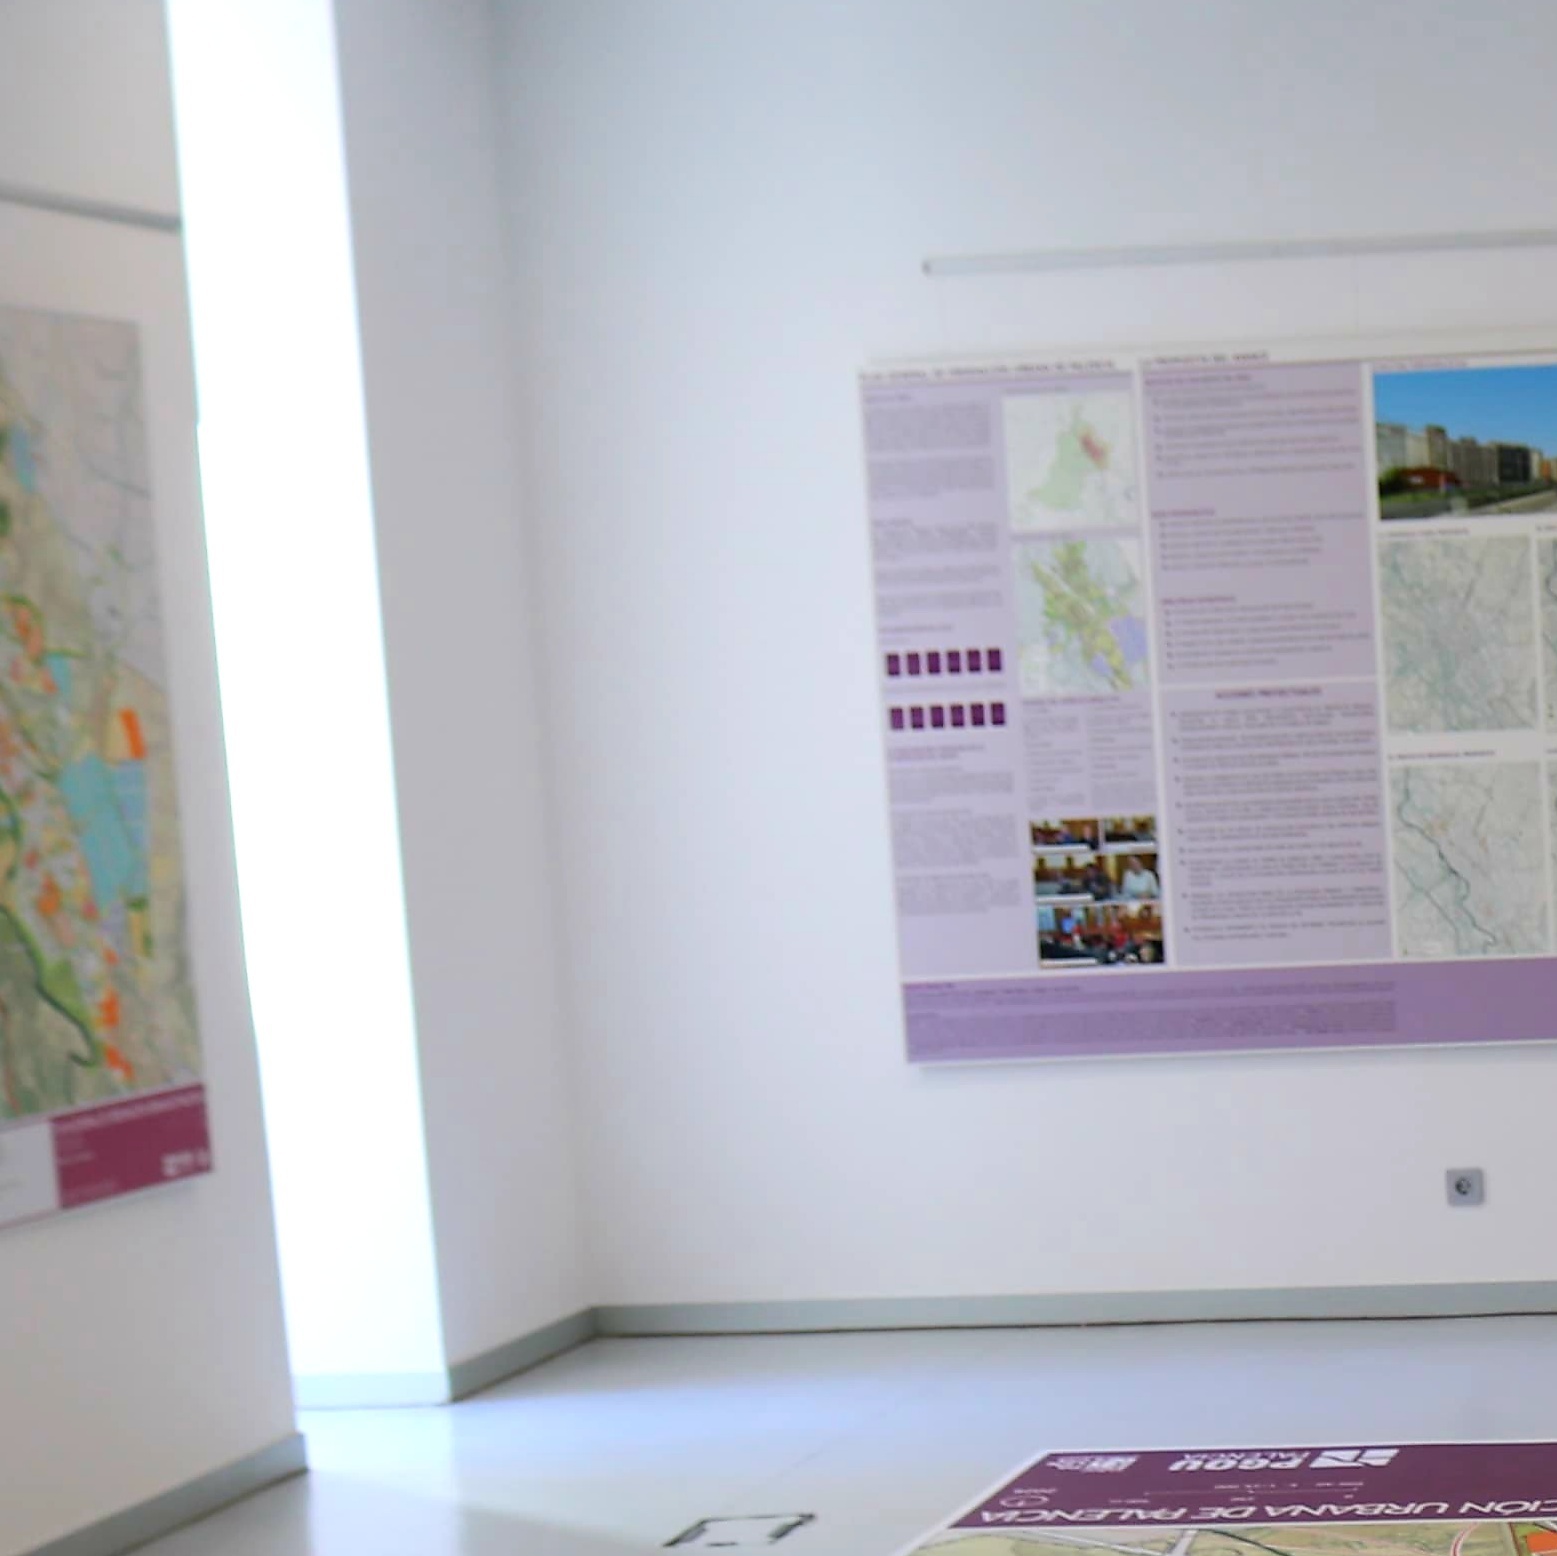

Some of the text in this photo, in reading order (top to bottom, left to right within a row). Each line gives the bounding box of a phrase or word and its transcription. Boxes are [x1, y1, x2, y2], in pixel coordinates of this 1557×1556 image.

[1168, 1459, 1304, 1471] PGOU
[981, 1508, 1186, 1522] PALENCIA
[1191, 1506, 1256, 1519] DE
[1265, 1503, 1449, 1518] URBANA
